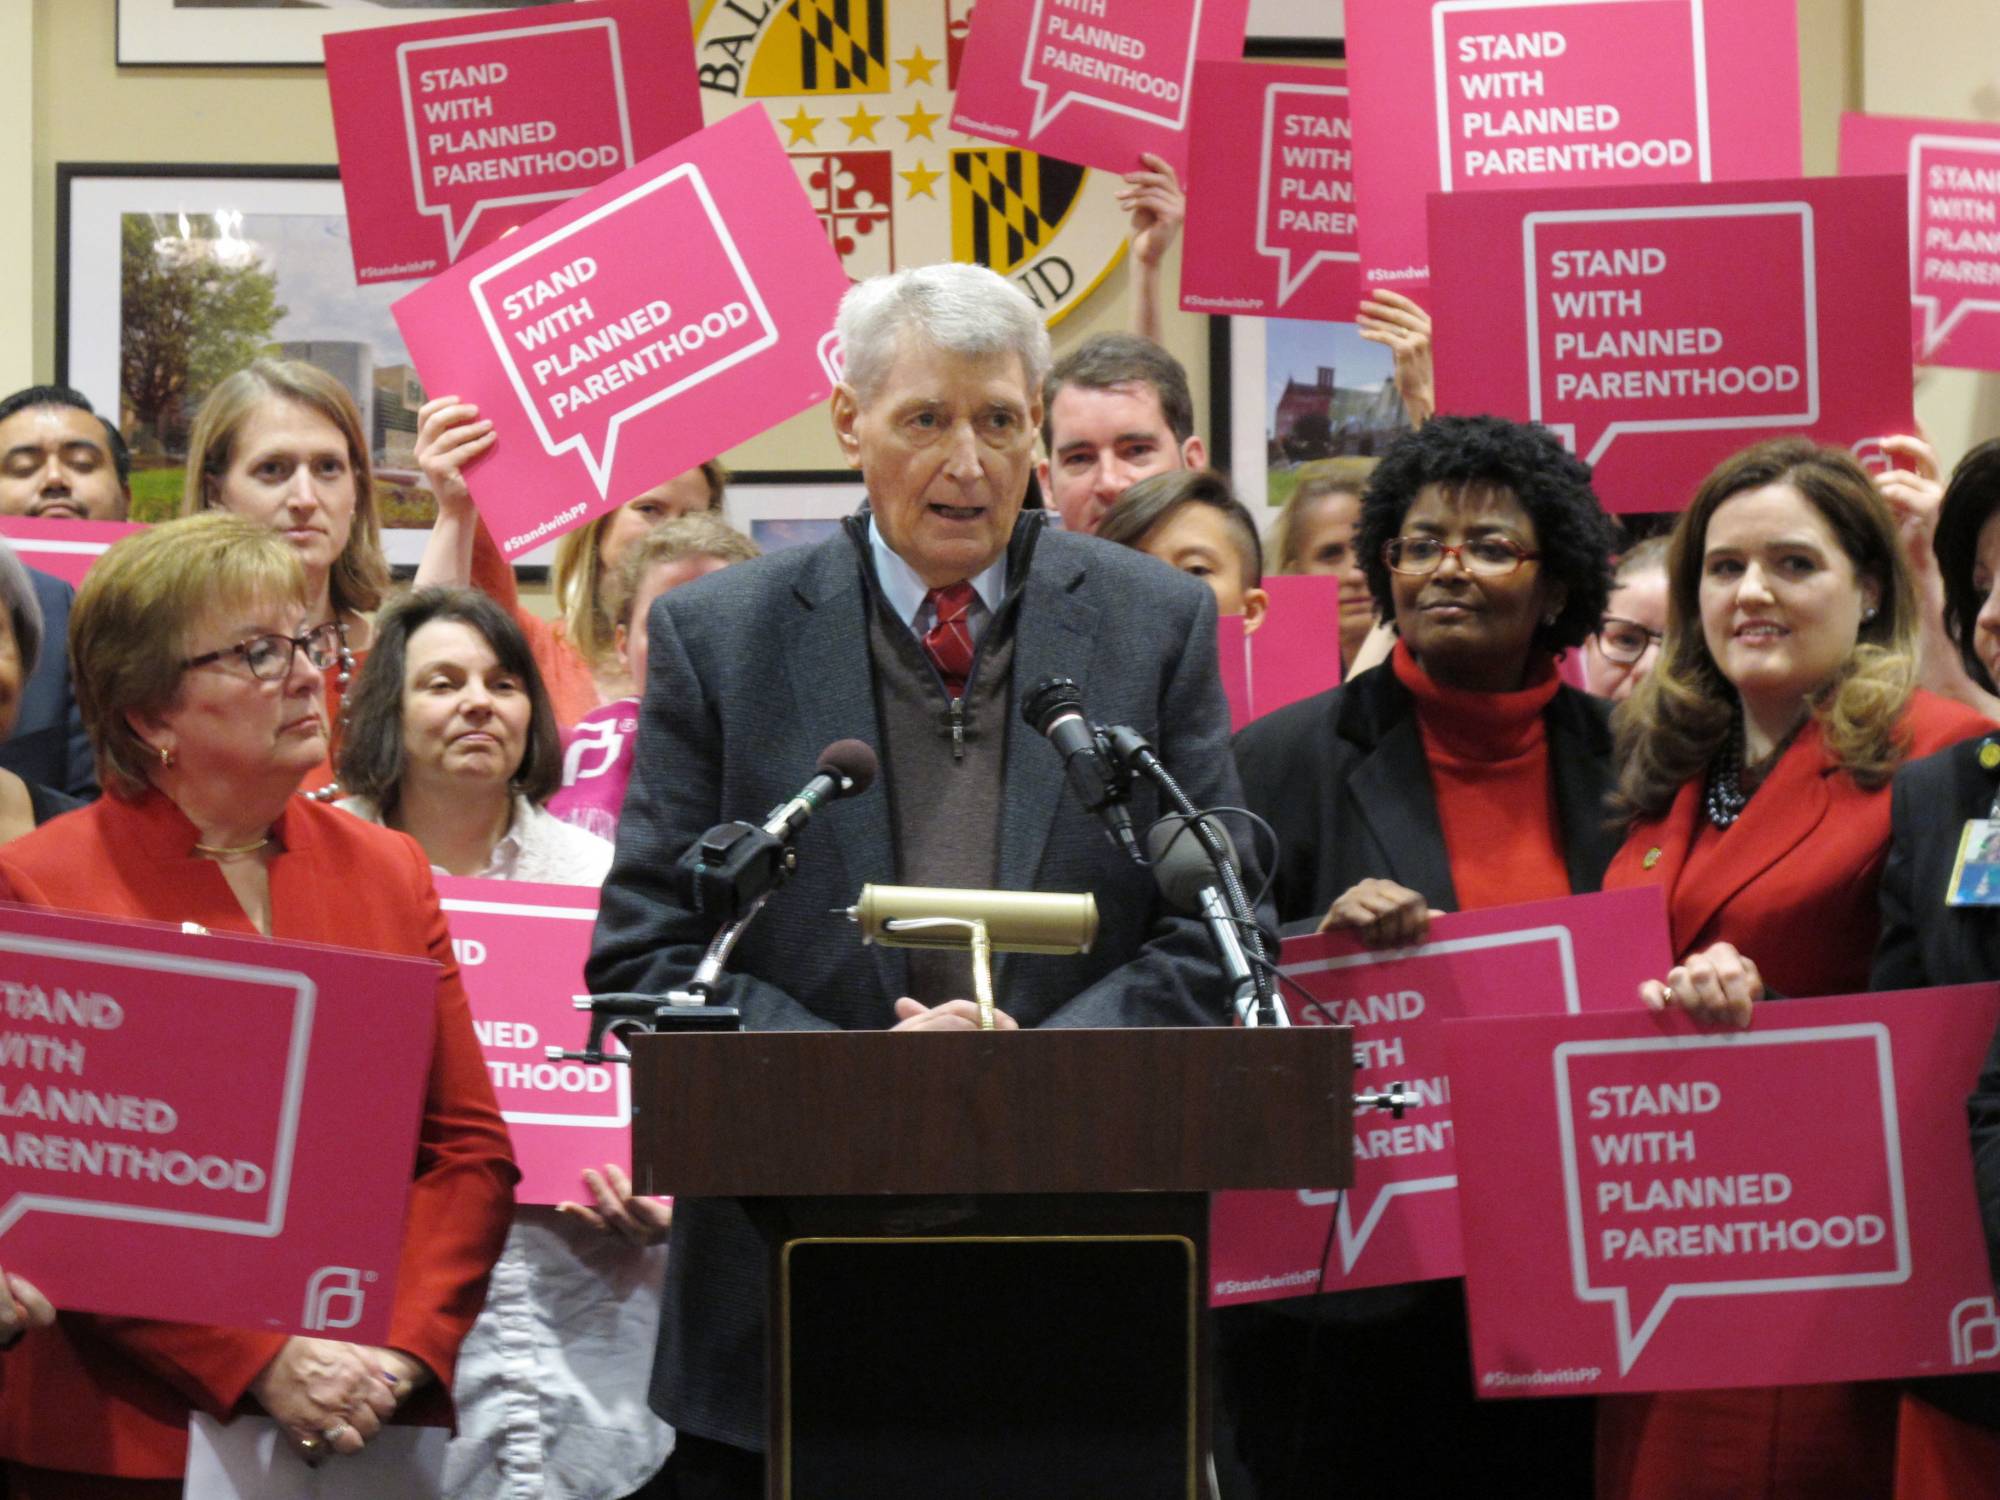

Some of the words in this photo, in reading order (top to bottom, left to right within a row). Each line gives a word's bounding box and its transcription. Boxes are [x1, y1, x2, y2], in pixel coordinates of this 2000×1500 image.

[1047, 15, 1146, 60] PLANNED
[1458, 31, 1567, 63] STAND
[419, 62, 509, 93] STAND
[1042, 45, 1181, 103] PARENTHOOD
[1459, 69, 1545, 101] WITH
[423, 95, 493, 124] WITH
[1283, 114, 1351, 139] STAN
[1463, 104, 1620, 139] PLANNED
[428, 120, 557, 155] PLANNED
[432, 145, 619, 187] PARENTHOOD
[1282, 145, 1352, 171] WITH
[1465, 139, 1693, 177] PARENTHOOD
[1280, 177, 1354, 203] PLAN
[1928, 165, 2000, 193] STAN
[1927, 195, 1996, 222] WITH
[1925, 226, 2000, 254] PLAN
[1367, 266, 1430, 282] #Standwi
[1551, 247, 1667, 279] STAND
[502, 256, 598, 321] STAND
[1551, 289, 1642, 319] WITH
[514, 297, 595, 352] WITH
[532, 300, 673, 386] PLANNED
[548, 301, 750, 419] PARENTHOOD
[1554, 327, 1723, 360] PLANNED
[1556, 364, 1800, 401] PARENTHOOD
[503, 502, 588, 553] #StandwithPP
[0, 980, 125, 1030] TAND
[471, 1020, 539, 1048] NED
[485, 1060, 612, 1093] THOOD
[0, 1082, 178, 1134] LANNED
[1587, 1081, 1721, 1119] STAND
[0, 1131, 266, 1194] ARENTHOOD
[1590, 1129, 1696, 1166] WITH
[1597, 1172, 1793, 1213] PLANNED
[1601, 1214, 1887, 1260] PARENTHOOD
[1482, 1367, 1601, 1387] #StandwithPP
